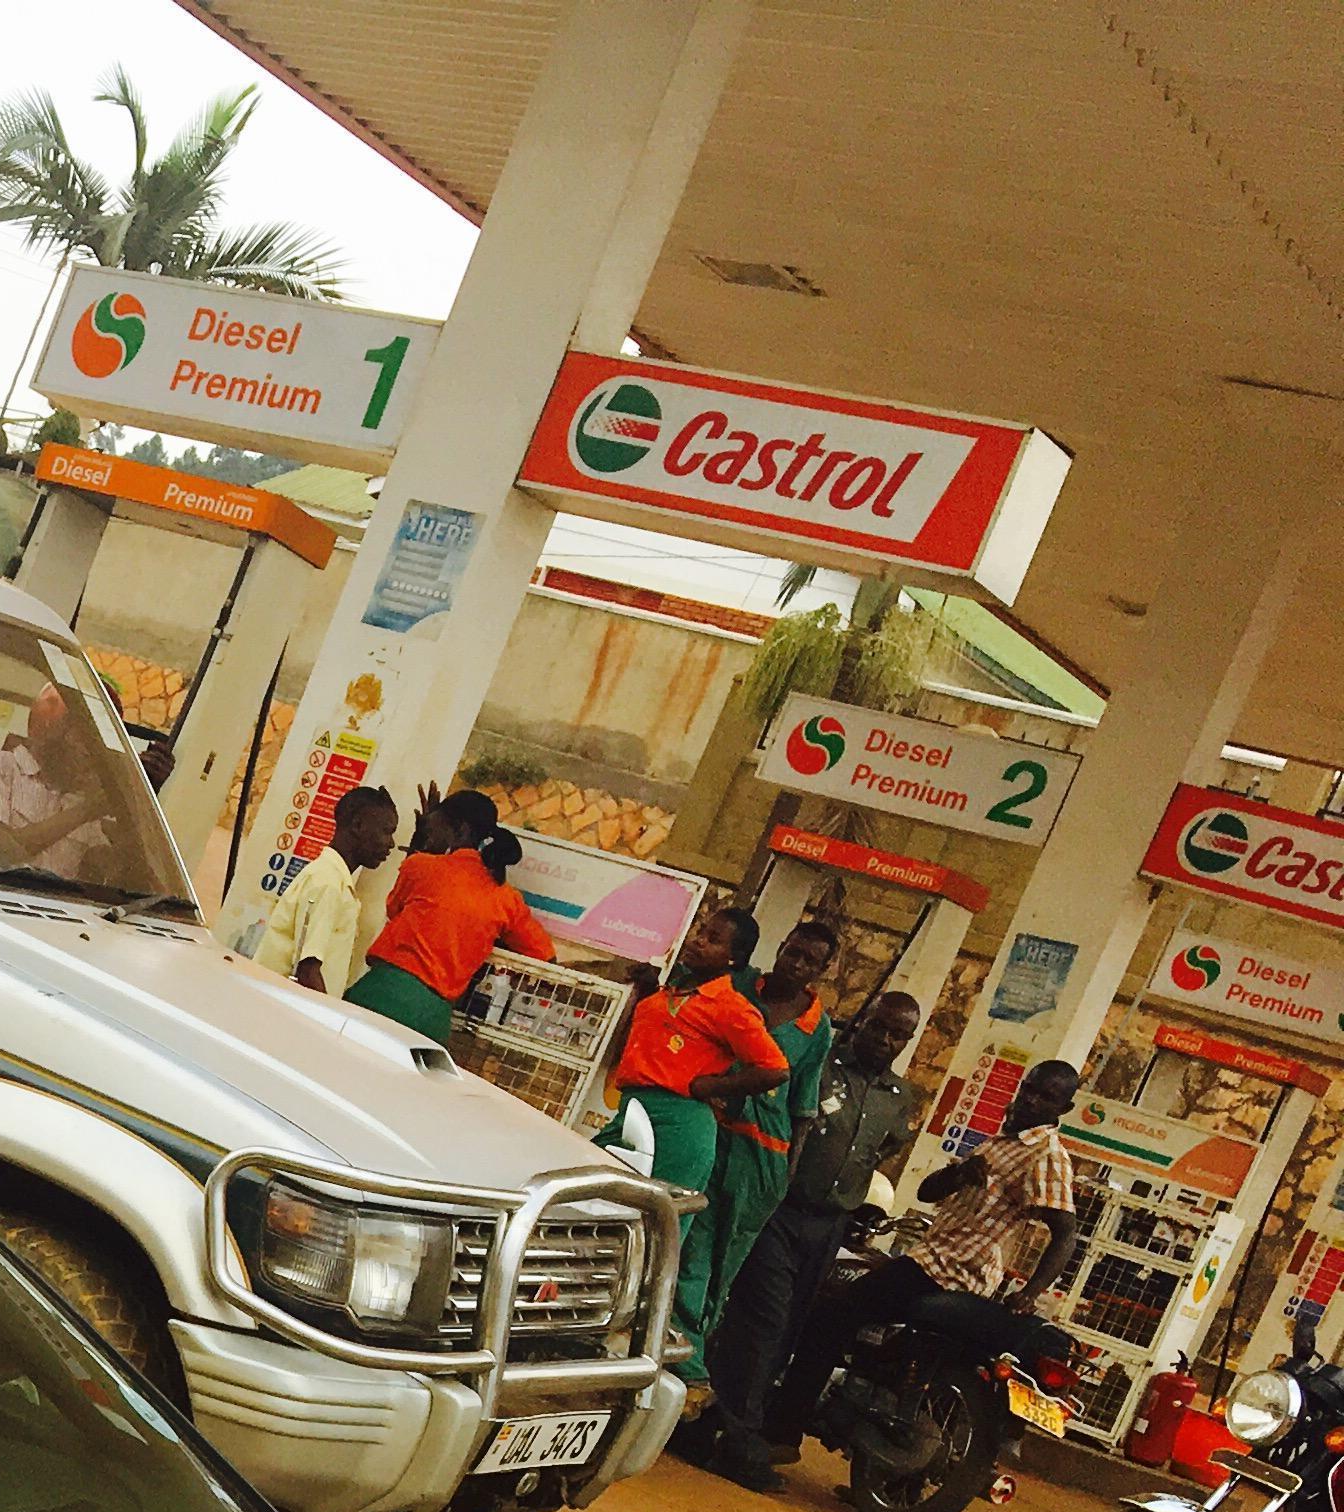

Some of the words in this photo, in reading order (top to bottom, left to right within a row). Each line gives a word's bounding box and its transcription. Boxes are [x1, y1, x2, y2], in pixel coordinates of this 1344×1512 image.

[188, 307, 302, 355] Diesel
[171, 359, 322, 414] Premium
[361, 336, 411, 430] 1
[51, 456, 112, 487] Diesel
[663, 410, 924, 518] Castrol
[163, 483, 254, 522] Premium
[864, 728, 954, 769] Diesel
[850, 763, 969, 812] Premium
[985, 759, 1048, 830] 2
[781, 834, 828, 857] Diesel
[867, 857, 935, 887] Premium
[1237, 956, 1312, 991] Diesel
[1225, 983, 1324, 1024] Premium
[1163, 1033, 1204, 1053] Diesel
[1234, 1053, 1291, 1080] Premium
[499, 1424, 542, 1465] UAL
[539, 1419, 598, 1462] 347S
